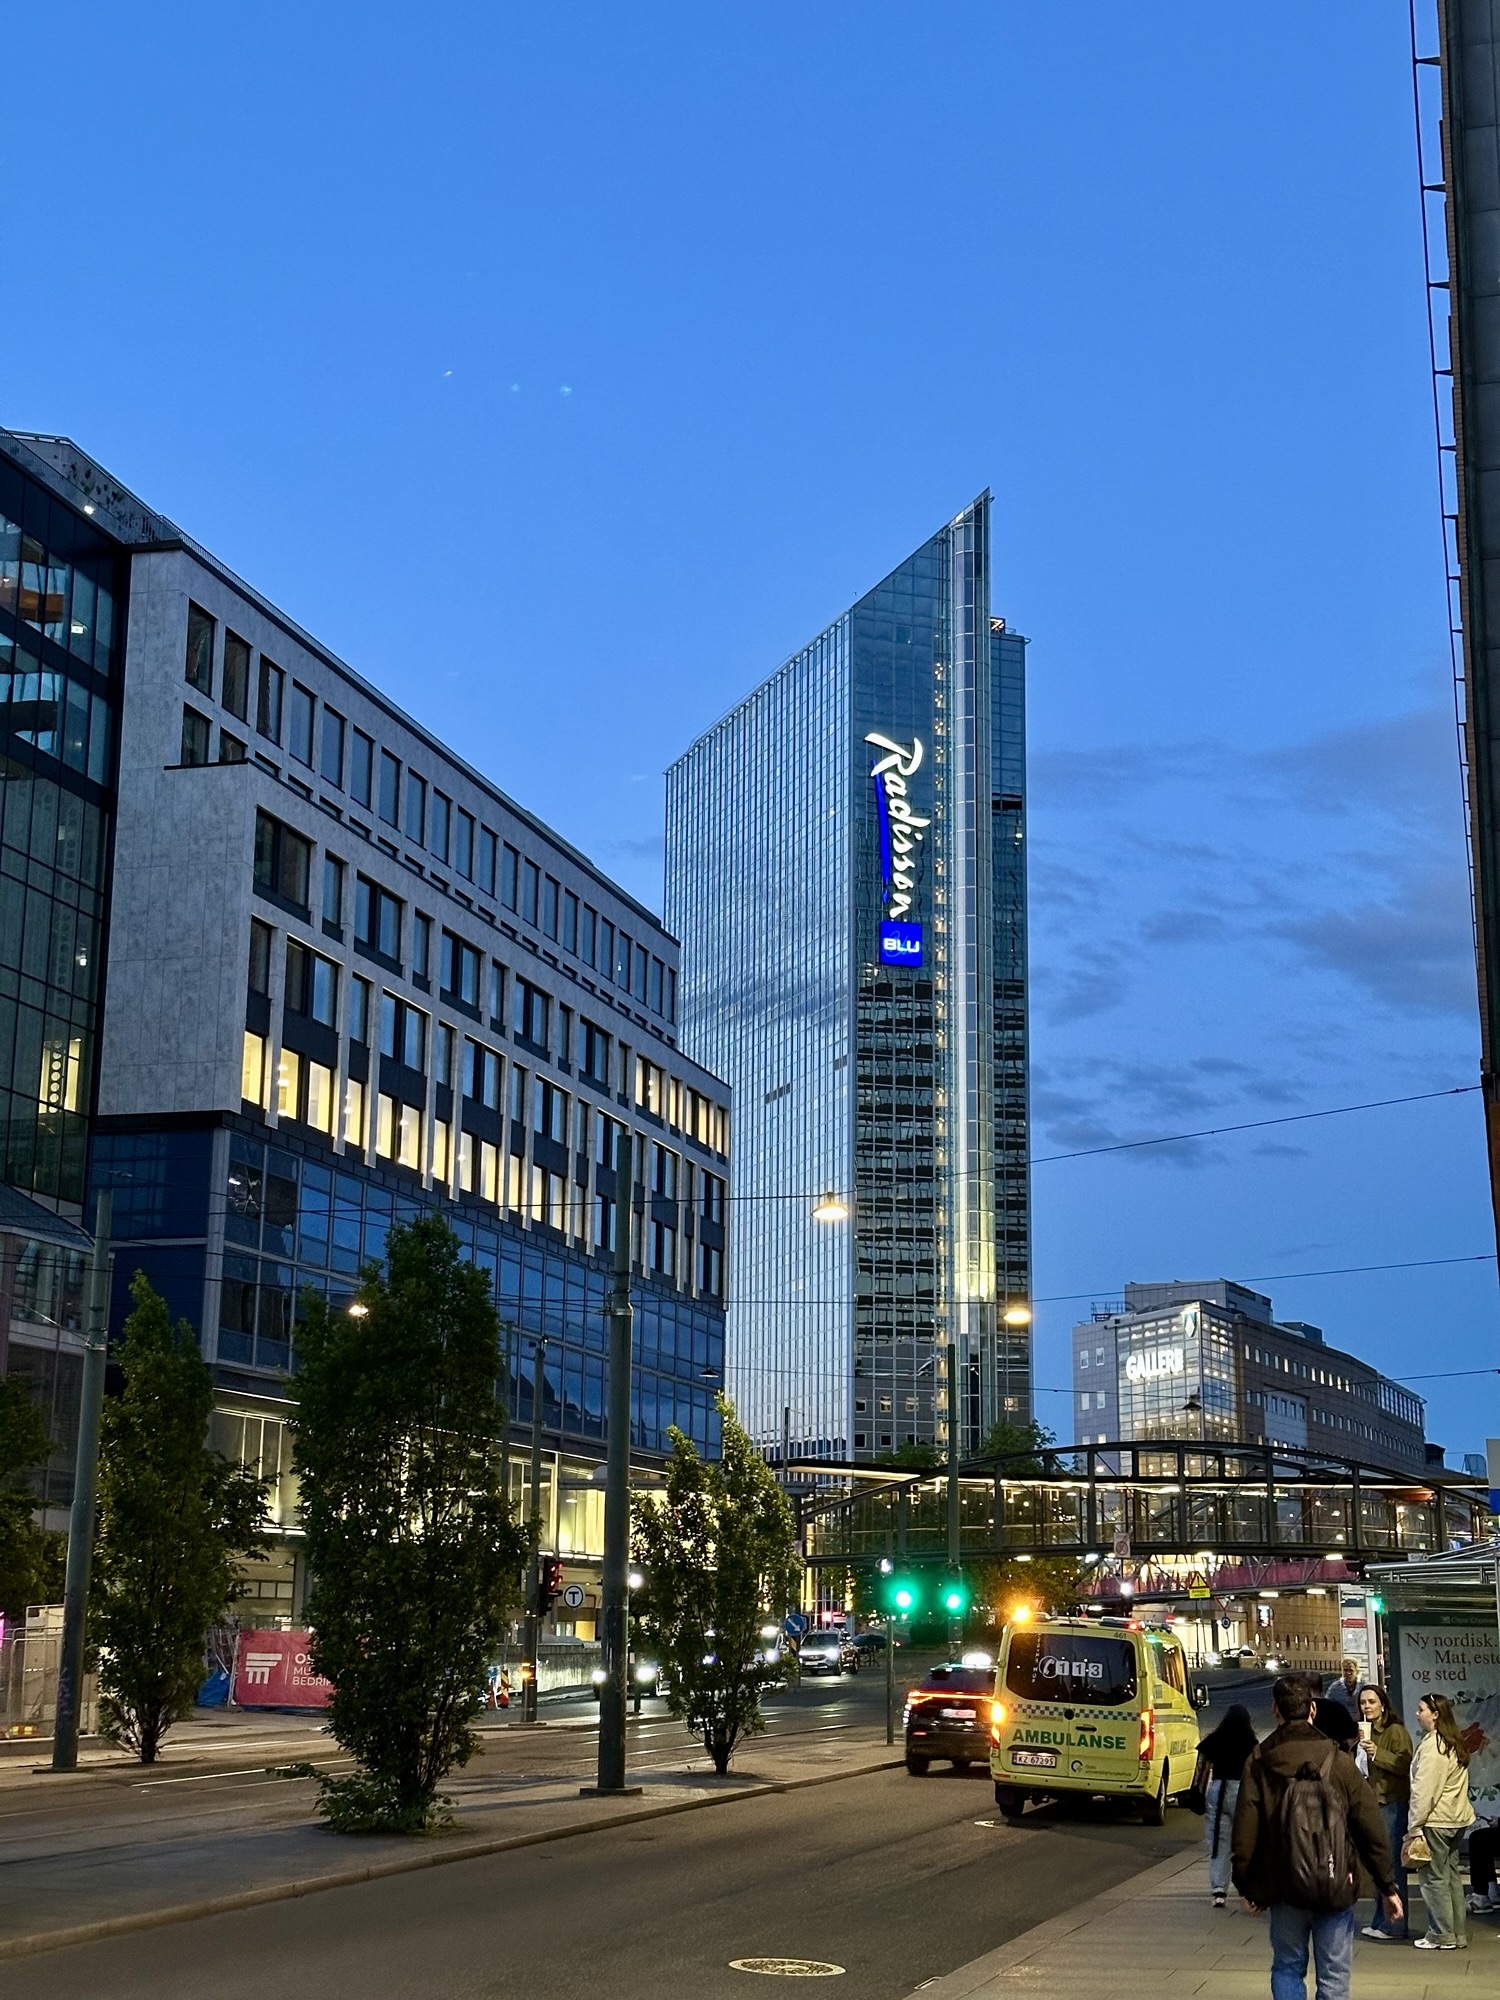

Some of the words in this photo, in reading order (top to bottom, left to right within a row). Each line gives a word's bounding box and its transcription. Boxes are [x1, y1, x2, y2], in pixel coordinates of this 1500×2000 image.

[864, 732, 931, 919] Radisson
[883, 937, 920, 953] BLU
[569, 1592, 579, 1604] T
[1406, 1633, 1429, 1649] Ny
[1433, 1633, 1498, 1648] nordisk.
[294, 1653, 315, 1664] OS
[1434, 1650, 1472, 1665] Mat,
[293, 1666, 315, 1675] MU
[1059, 1662, 1100, 1677] 113
[1411, 1669, 1432, 1683] og
[1435, 1667, 1467, 1681] sted
[1012, 1729, 1126, 1749] AMBULANSE
[1018, 1755, 1029, 1763] KZ
[1030, 1756, 1054, 1766] 67295
